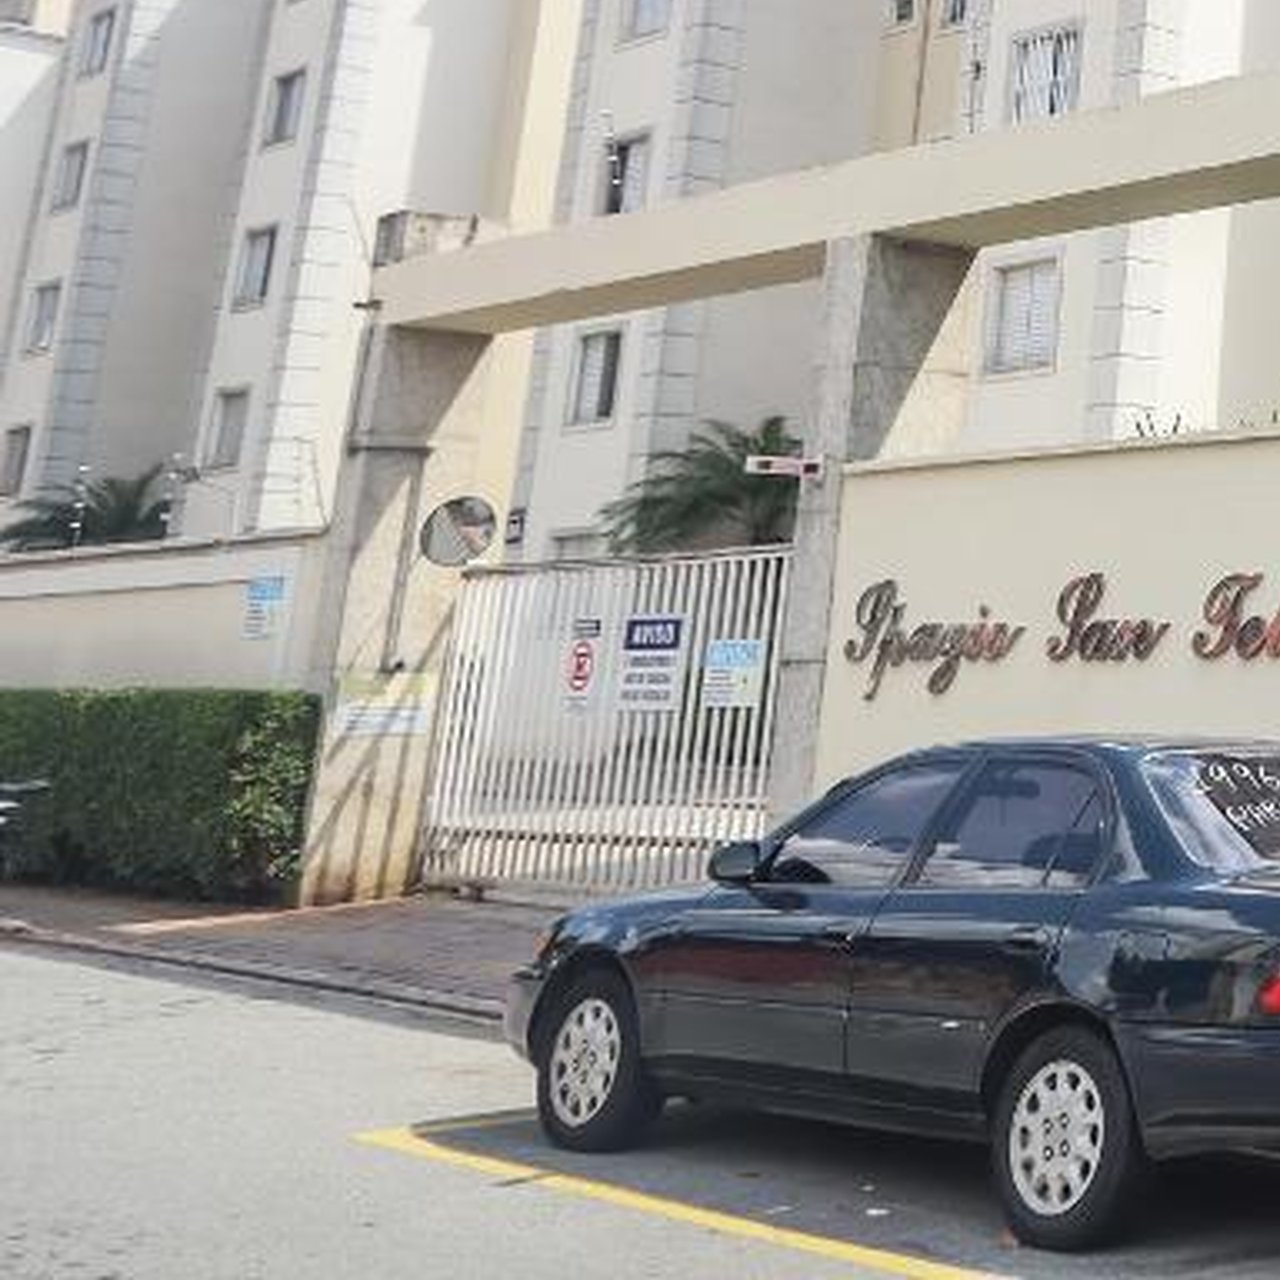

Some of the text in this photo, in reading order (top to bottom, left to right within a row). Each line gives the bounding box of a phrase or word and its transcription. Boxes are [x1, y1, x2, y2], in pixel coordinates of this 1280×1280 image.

[632, 623, 675, 645] AVISO
[845, 578, 1025, 702] Spazio
[1046, 571, 1172, 663] San
